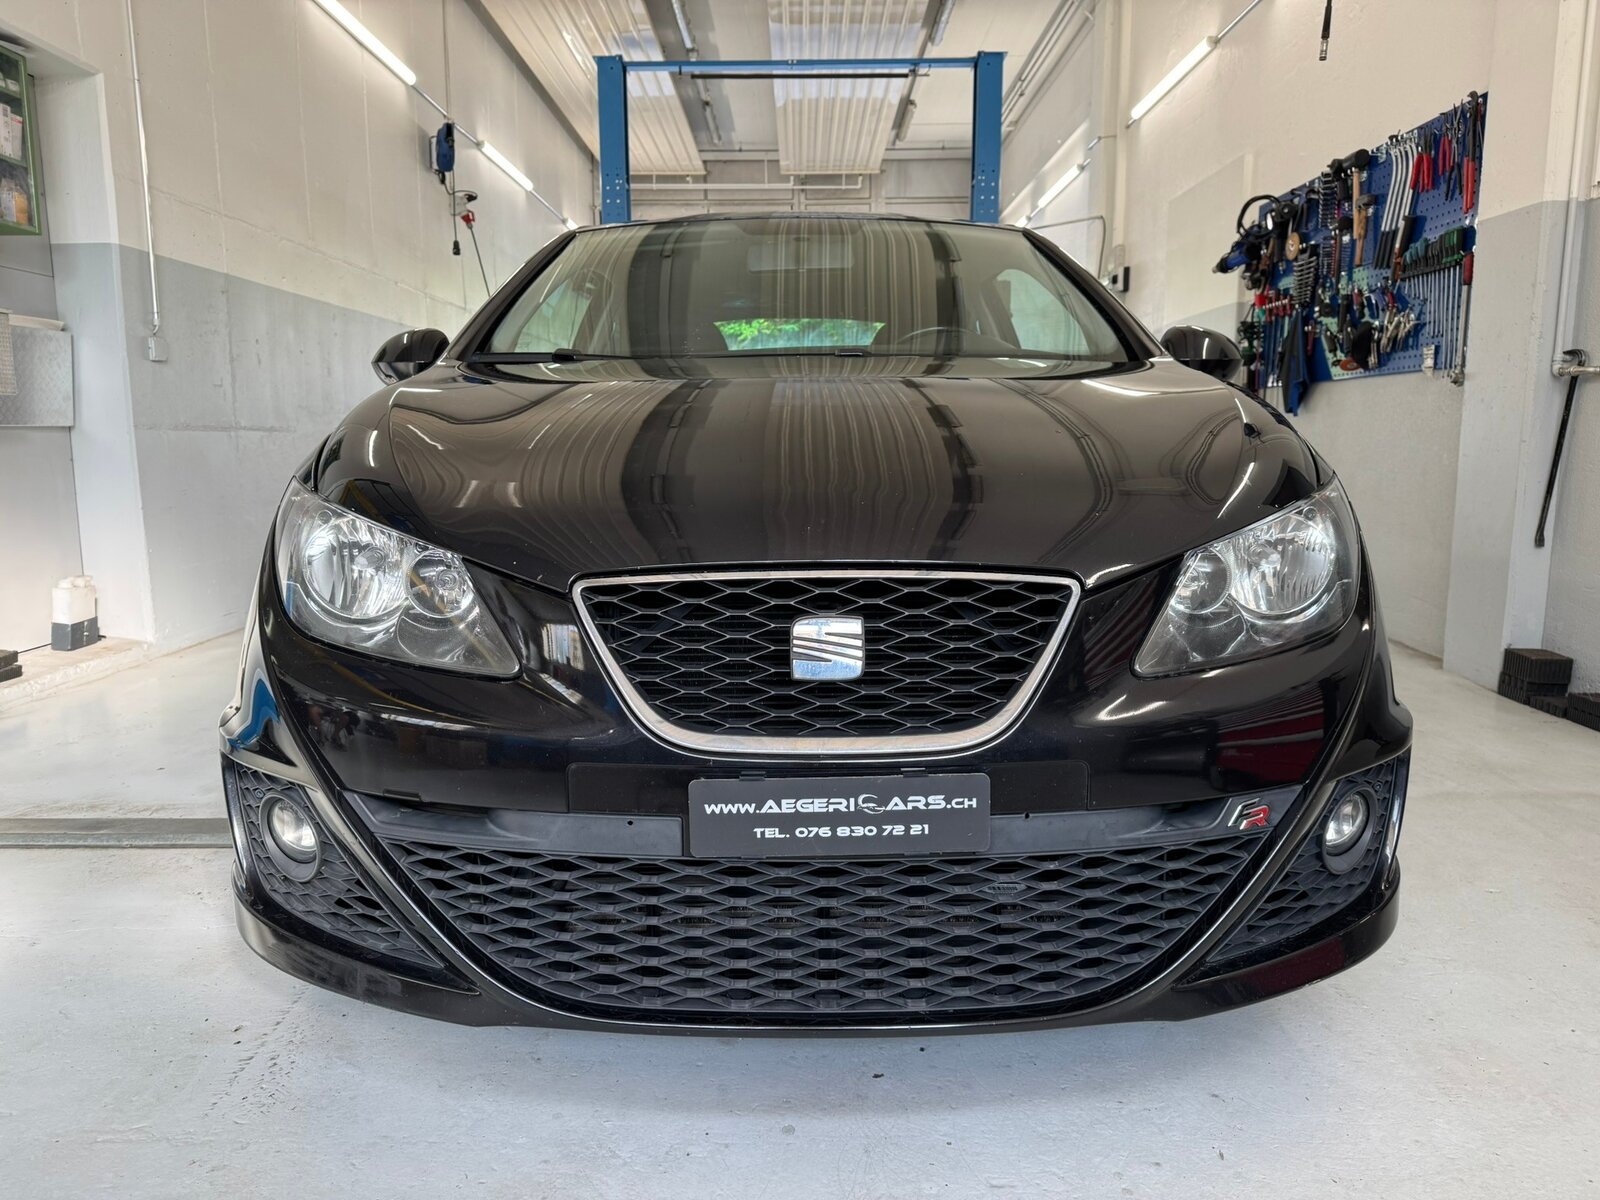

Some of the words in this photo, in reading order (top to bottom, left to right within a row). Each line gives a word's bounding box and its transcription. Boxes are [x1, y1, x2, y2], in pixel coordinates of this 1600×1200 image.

[1227, 797, 1269, 830] FR
[753, 827, 790, 838] TEL.
[795, 826, 832, 838] 076
[836, 825, 878, 837] 830
[881, 825, 905, 836] 72
[909, 824, 929, 835] 21
